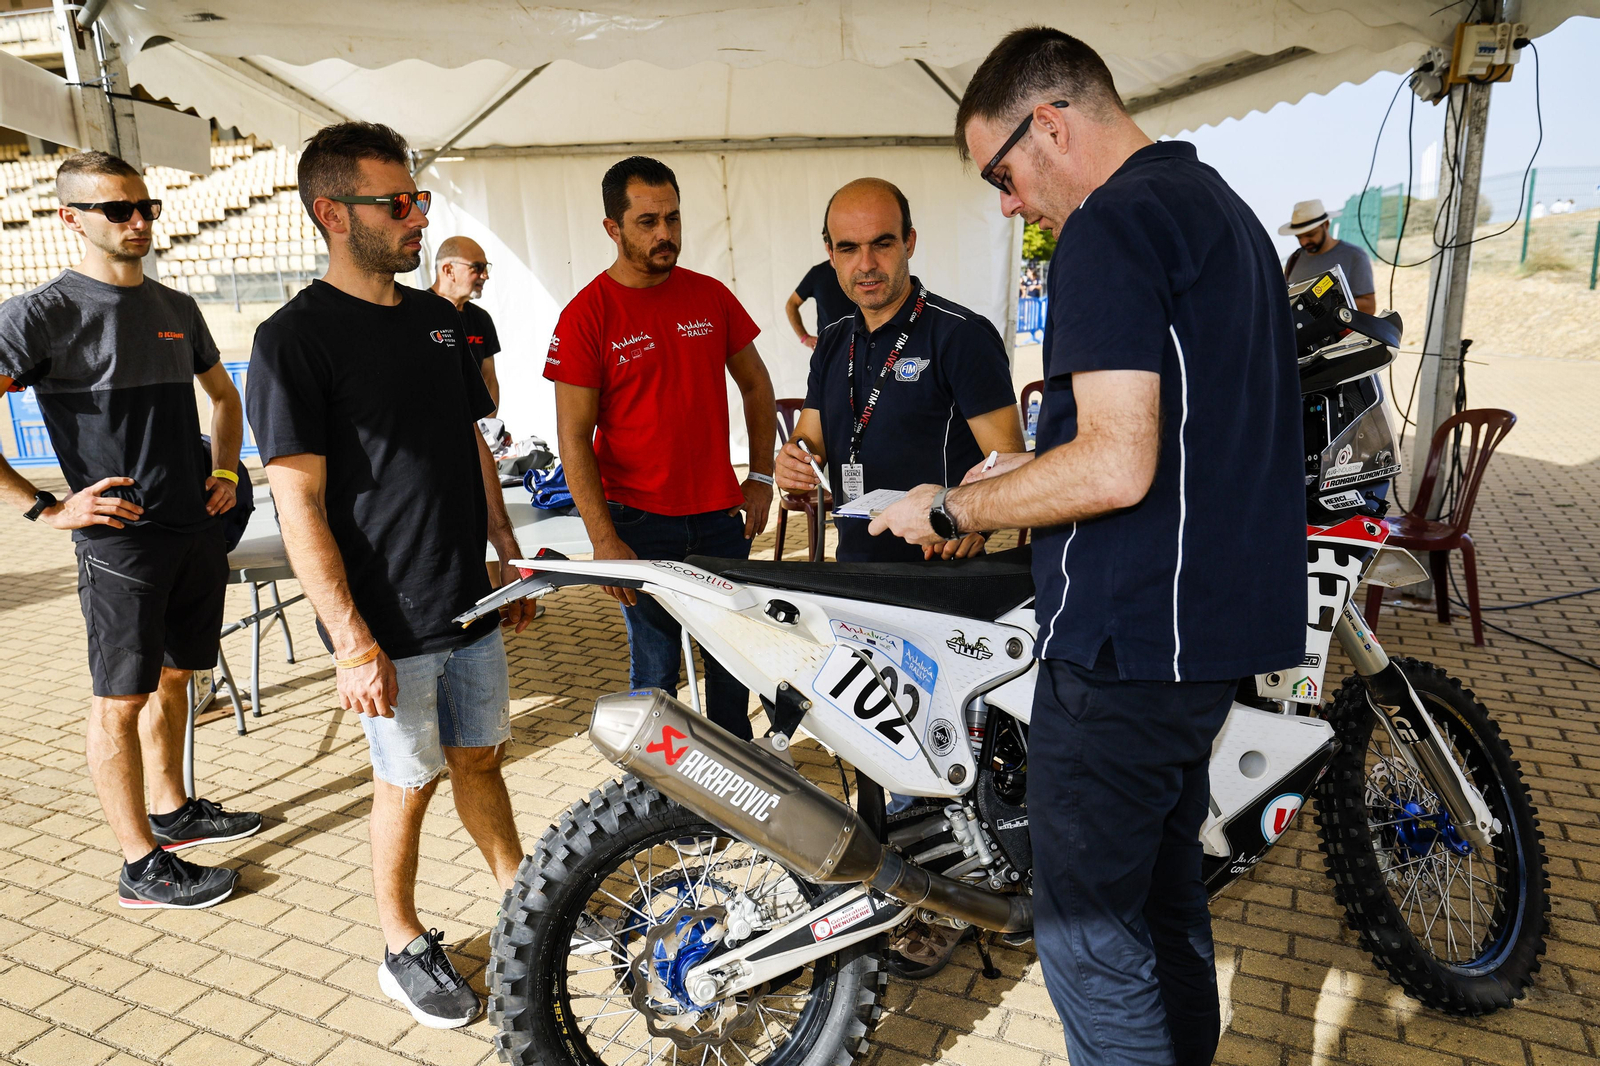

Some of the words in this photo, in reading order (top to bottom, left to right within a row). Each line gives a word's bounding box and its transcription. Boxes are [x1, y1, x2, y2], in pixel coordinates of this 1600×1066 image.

[687, 327, 709, 338] RALLY
[901, 364, 916, 374] FIM
[1330, 475, 1357, 486] ROMAIN
[839, 622, 897, 650] Andalucía
[908, 663, 927, 681] RALLY
[829, 649, 920, 745] 102
[677, 749, 781, 822] AKRAPOVIČ
[1273, 807, 1297, 835] U
[832, 909, 870, 930] MENUISERIE
